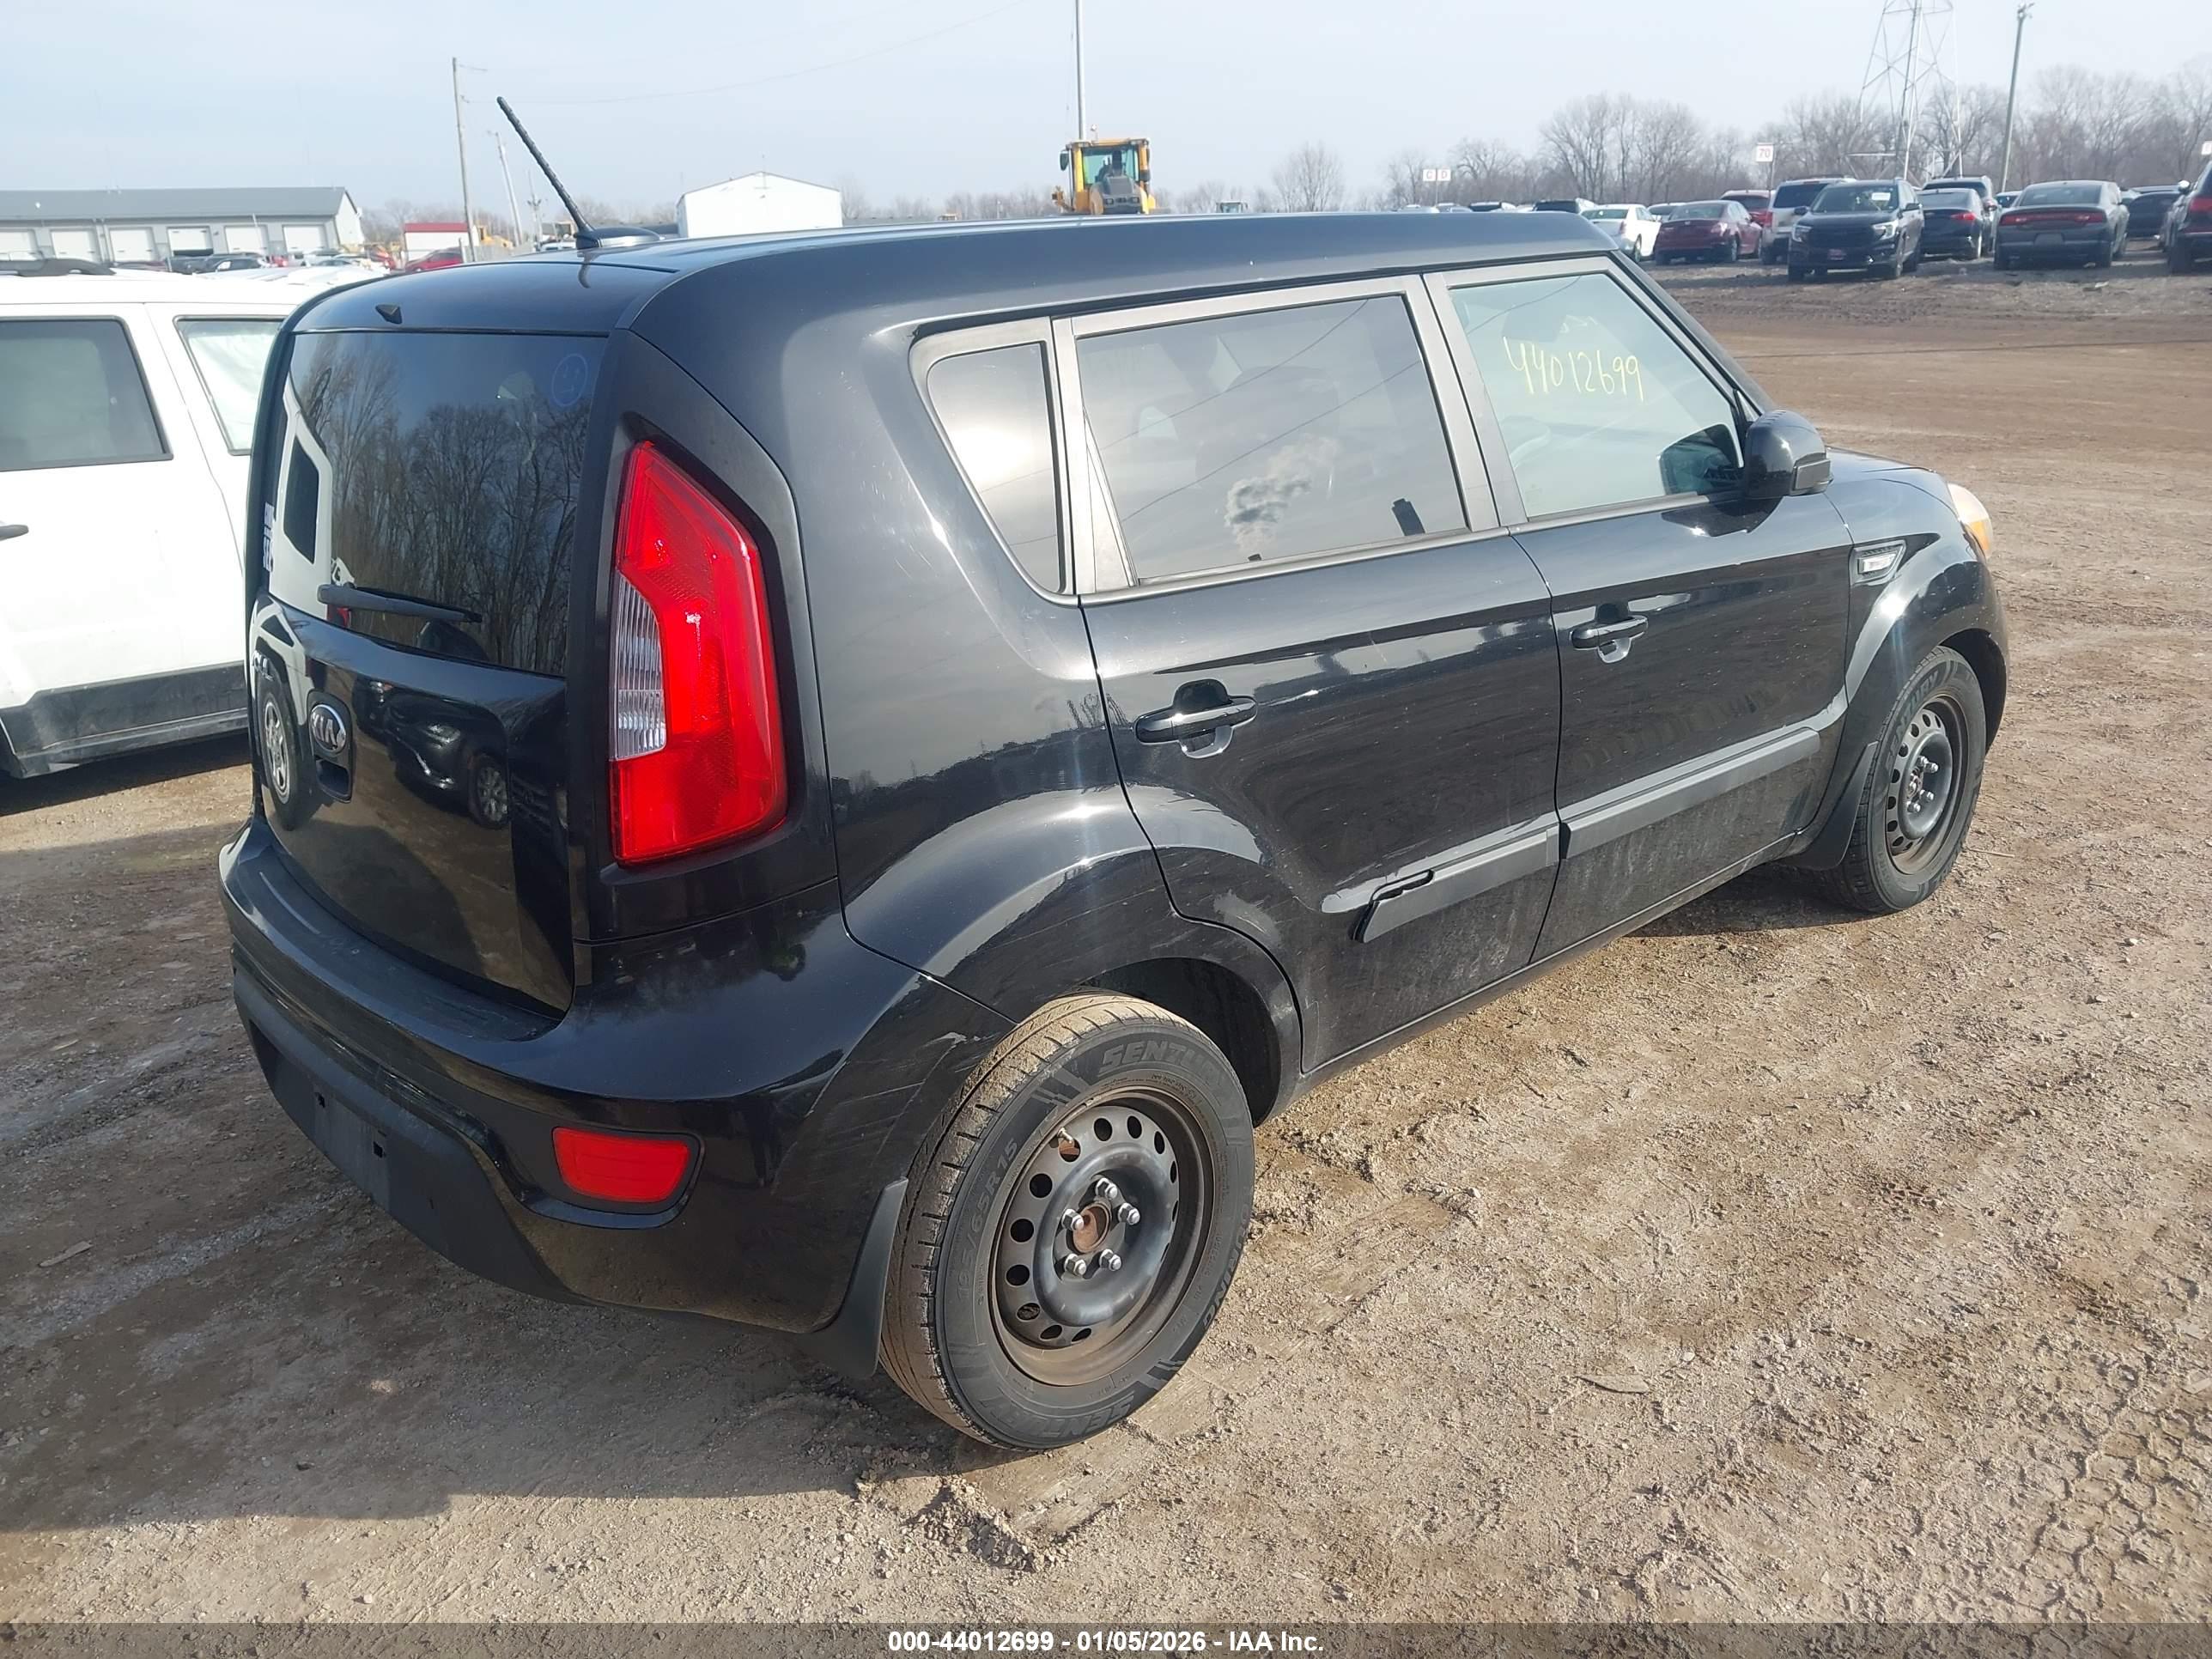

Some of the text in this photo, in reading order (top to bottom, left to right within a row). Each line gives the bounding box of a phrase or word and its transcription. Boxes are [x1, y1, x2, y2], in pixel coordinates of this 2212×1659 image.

[1759, 148, 1771, 158] 70
[1503, 336, 1644, 402] 44012699
[312, 712, 337, 745] KIA
